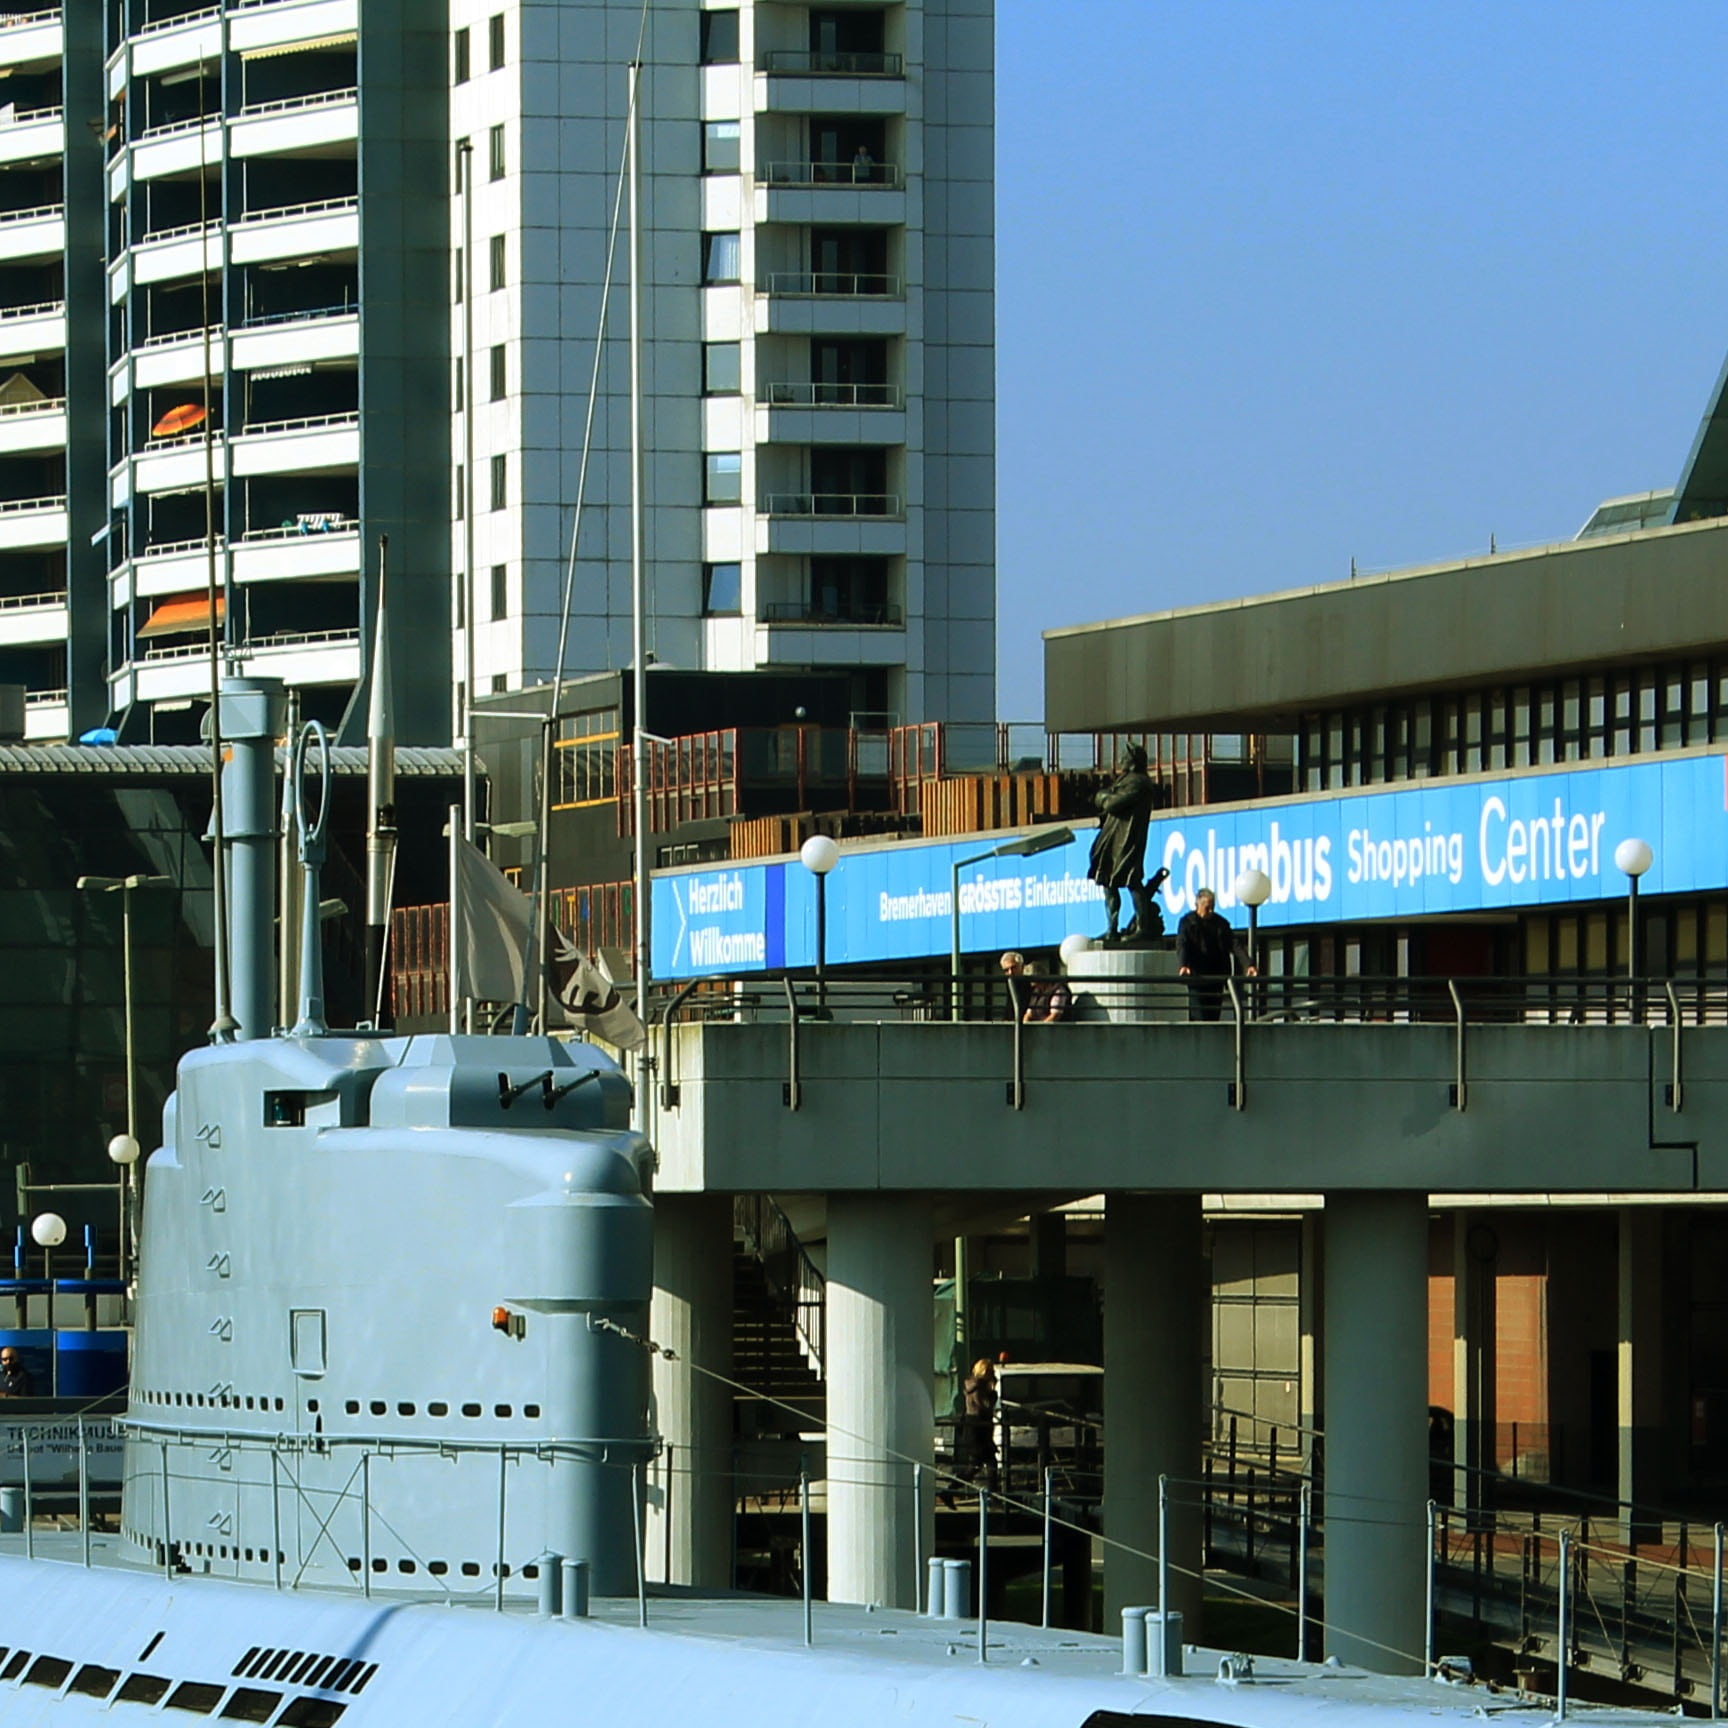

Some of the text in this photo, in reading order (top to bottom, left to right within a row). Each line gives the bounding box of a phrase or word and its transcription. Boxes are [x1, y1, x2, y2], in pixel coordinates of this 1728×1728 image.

[1162, 796, 1606, 915] Columbus Shopping Center
[689, 871, 743, 915] Herzlich
[958, 873, 1022, 915] GRÖSSTES
